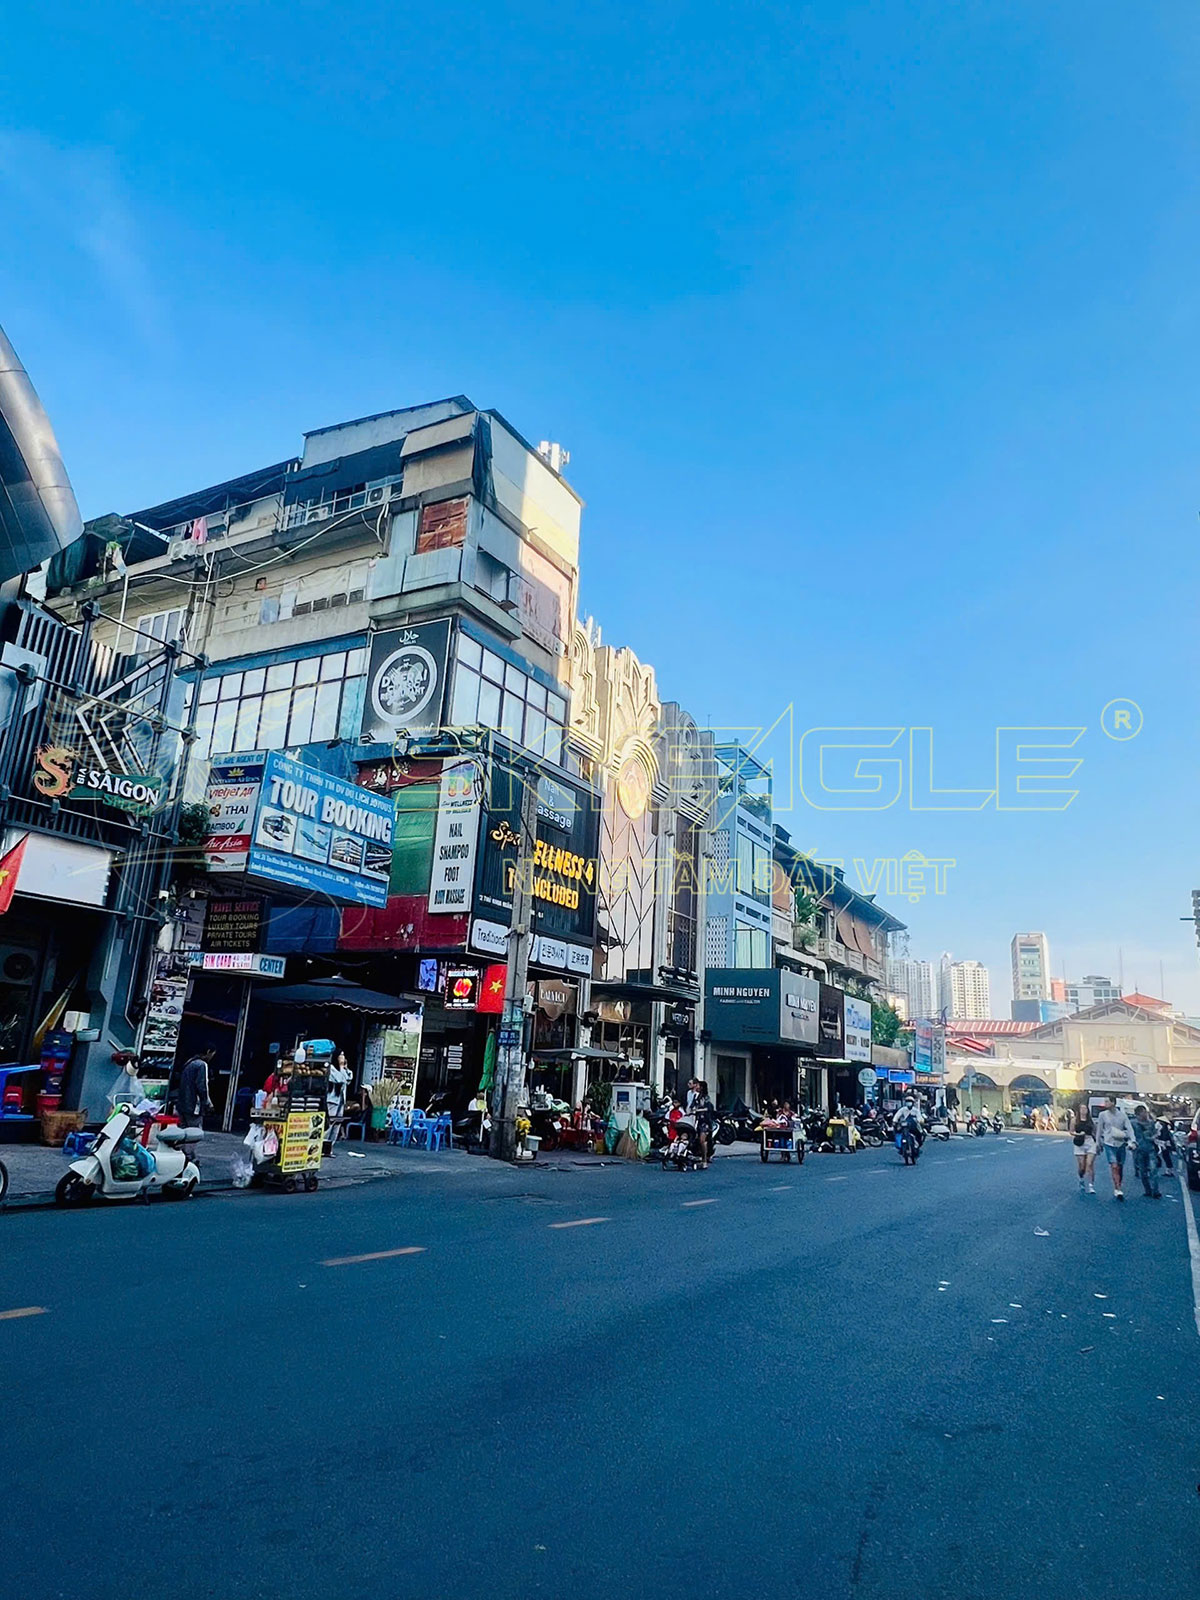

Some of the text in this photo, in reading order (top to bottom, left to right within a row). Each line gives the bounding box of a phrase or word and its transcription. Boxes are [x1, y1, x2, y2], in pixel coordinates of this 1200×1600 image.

[223, 756, 236, 764] ARE
[237, 754, 254, 763] AGENT
[76, 768, 87, 785] BIA
[295, 767, 304, 778] TY
[544, 779, 560, 795] Nail
[548, 795, 555, 806] &
[225, 805, 249, 815] THAI
[270, 774, 393, 844] TOUR BOOKING
[537, 805, 572, 828] assage
[449, 823, 463, 838] NAIL
[439, 844, 469, 860] SHAMPOO
[533, 839, 585, 881] ELLNESS
[444, 867, 460, 882] FOOT
[532, 875, 579, 910] NCLUDED
[211, 901, 260, 912] TRAVEL SERVICE
[209, 913, 259, 922] TOUR BOOKING
[208, 922, 258, 931] LUXURY TOURS
[207, 931, 256, 939] PRIVATE TOURS
[478, 927, 505, 946] Traditiona
[210, 940, 250, 948] AIR TICKETS
[260, 957, 284, 974] CENTER
[713, 986, 770, 997] MINH NGUYEN
